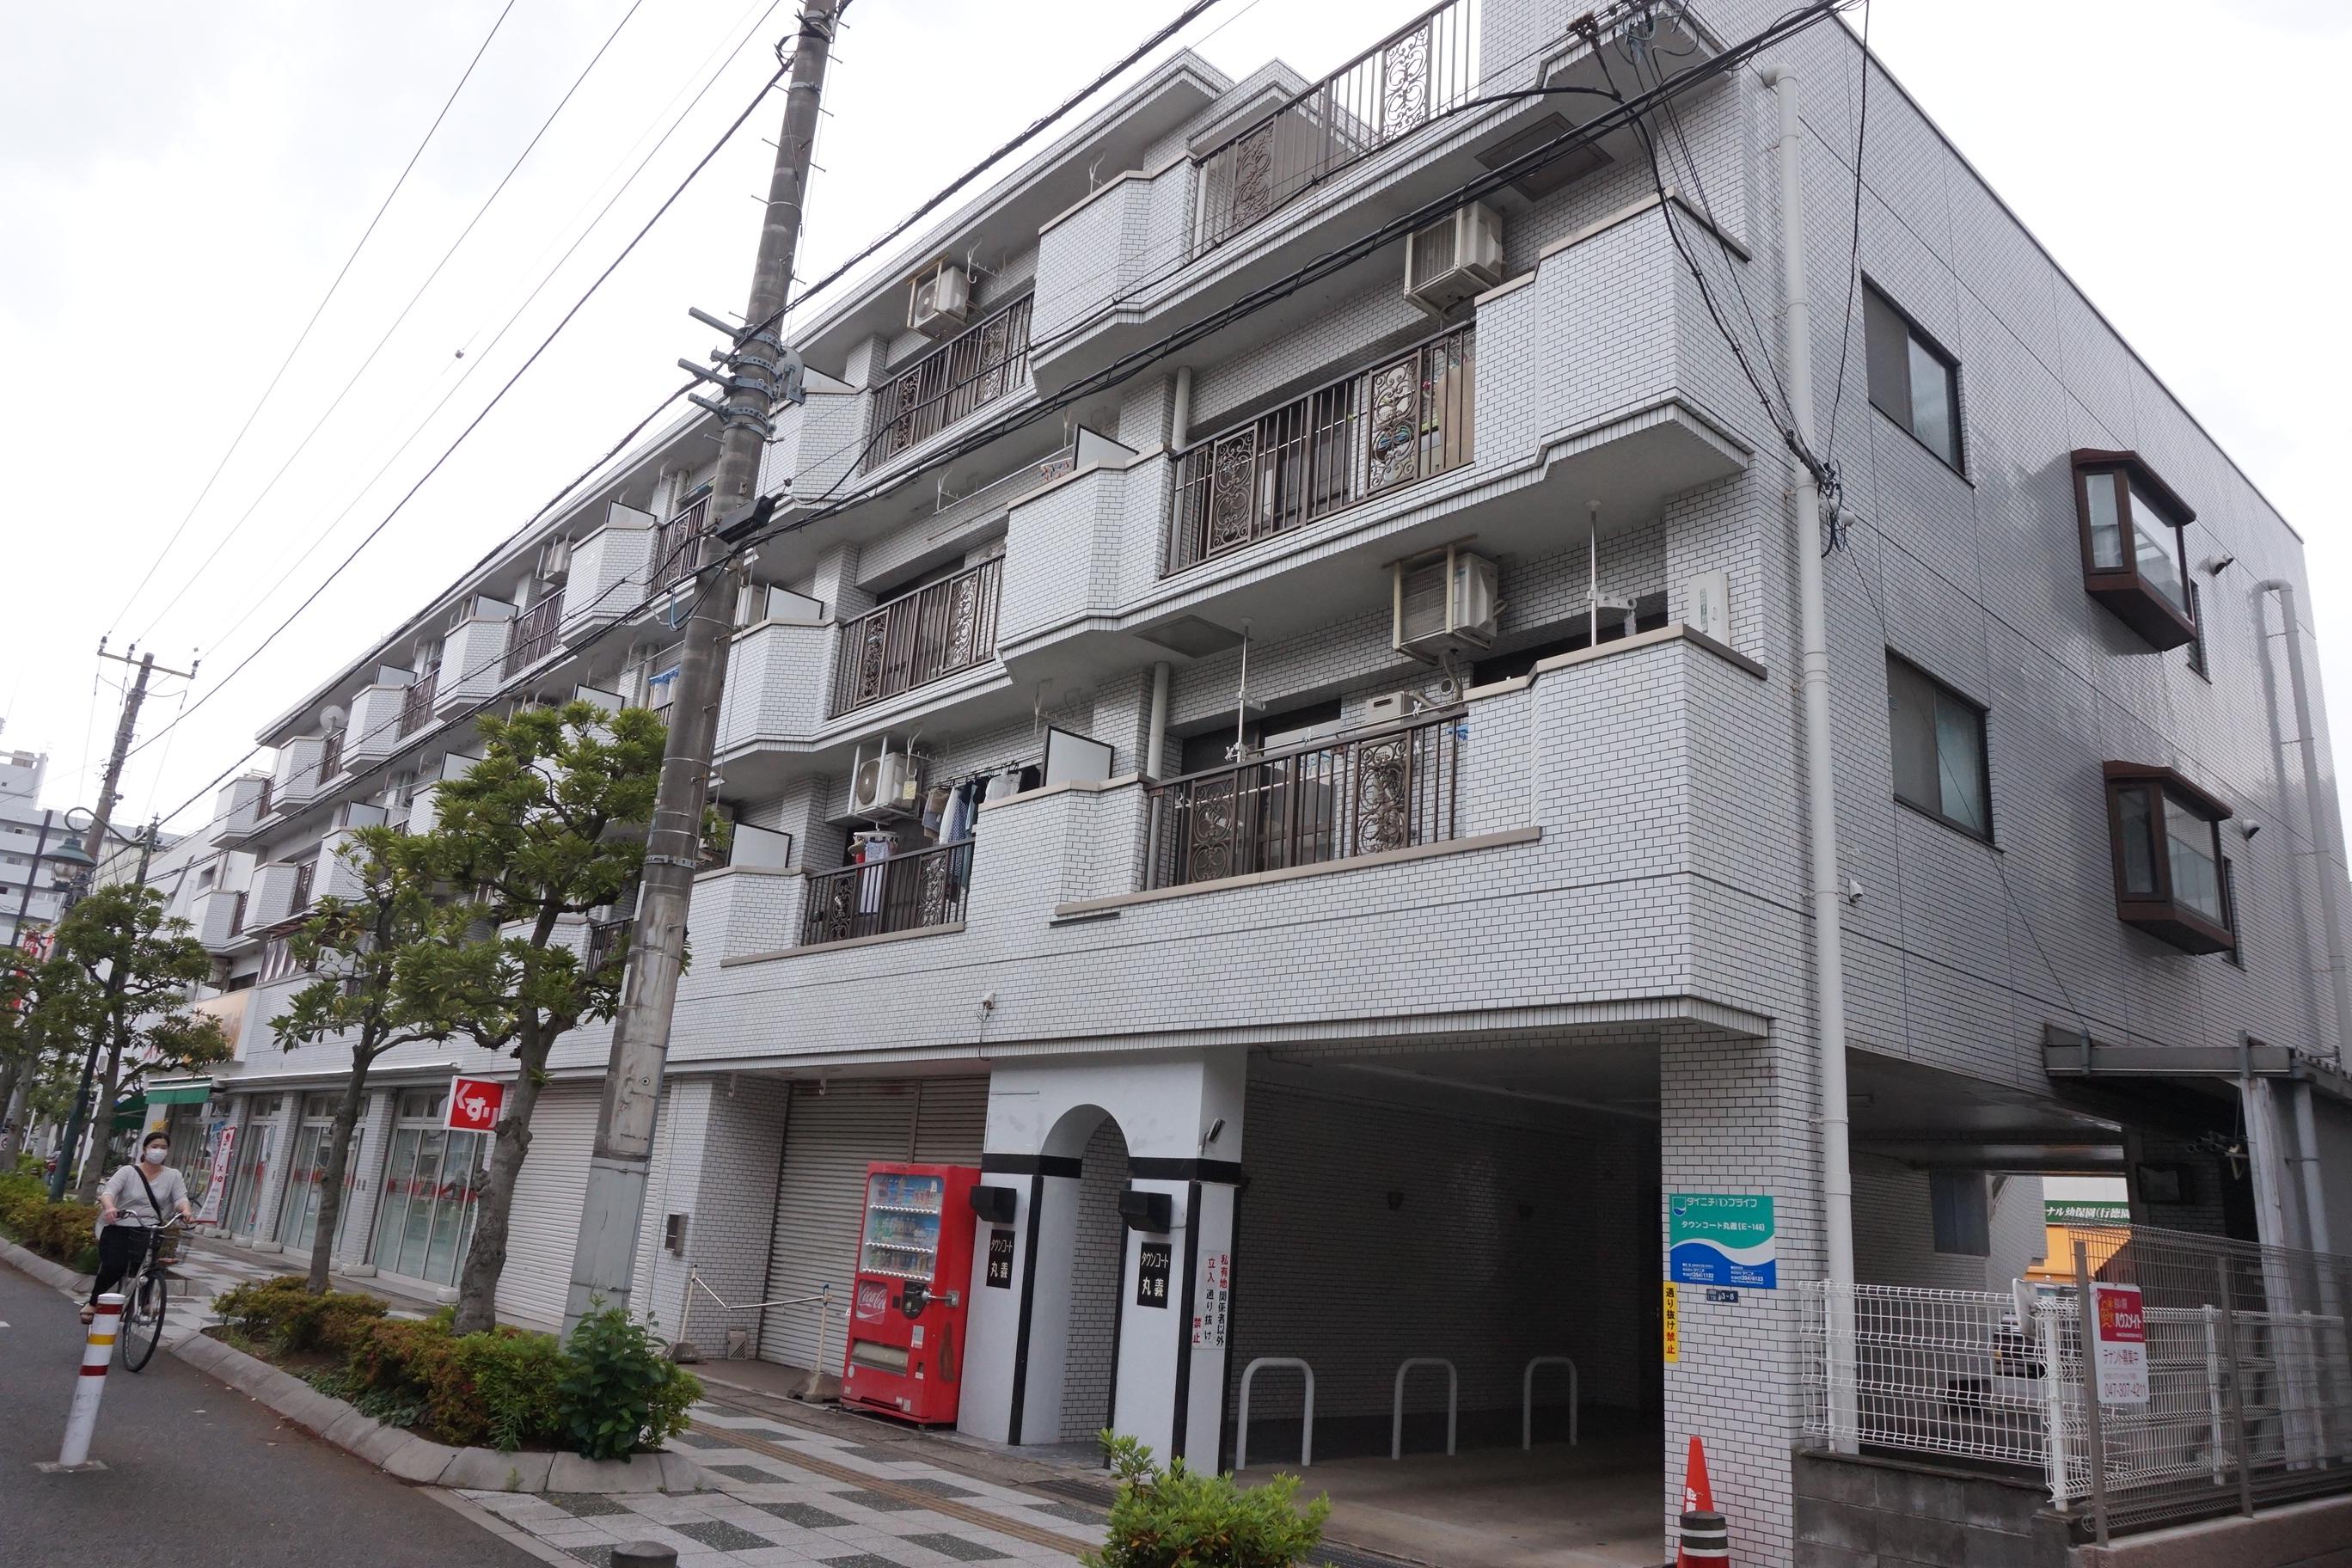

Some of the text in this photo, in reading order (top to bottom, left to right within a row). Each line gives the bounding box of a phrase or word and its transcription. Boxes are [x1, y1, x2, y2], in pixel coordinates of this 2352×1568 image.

[456, 1083, 499, 1128] くすり
[991, 1239, 1013, 1253] タウンコート
[1142, 1252, 1168, 1268] タウンコート
[1142, 1277, 1164, 1297] 丸義
[1192, 1317, 1202, 1344] 禁止
[1666, 1287, 1675, 1355] 通り抜け禁止
